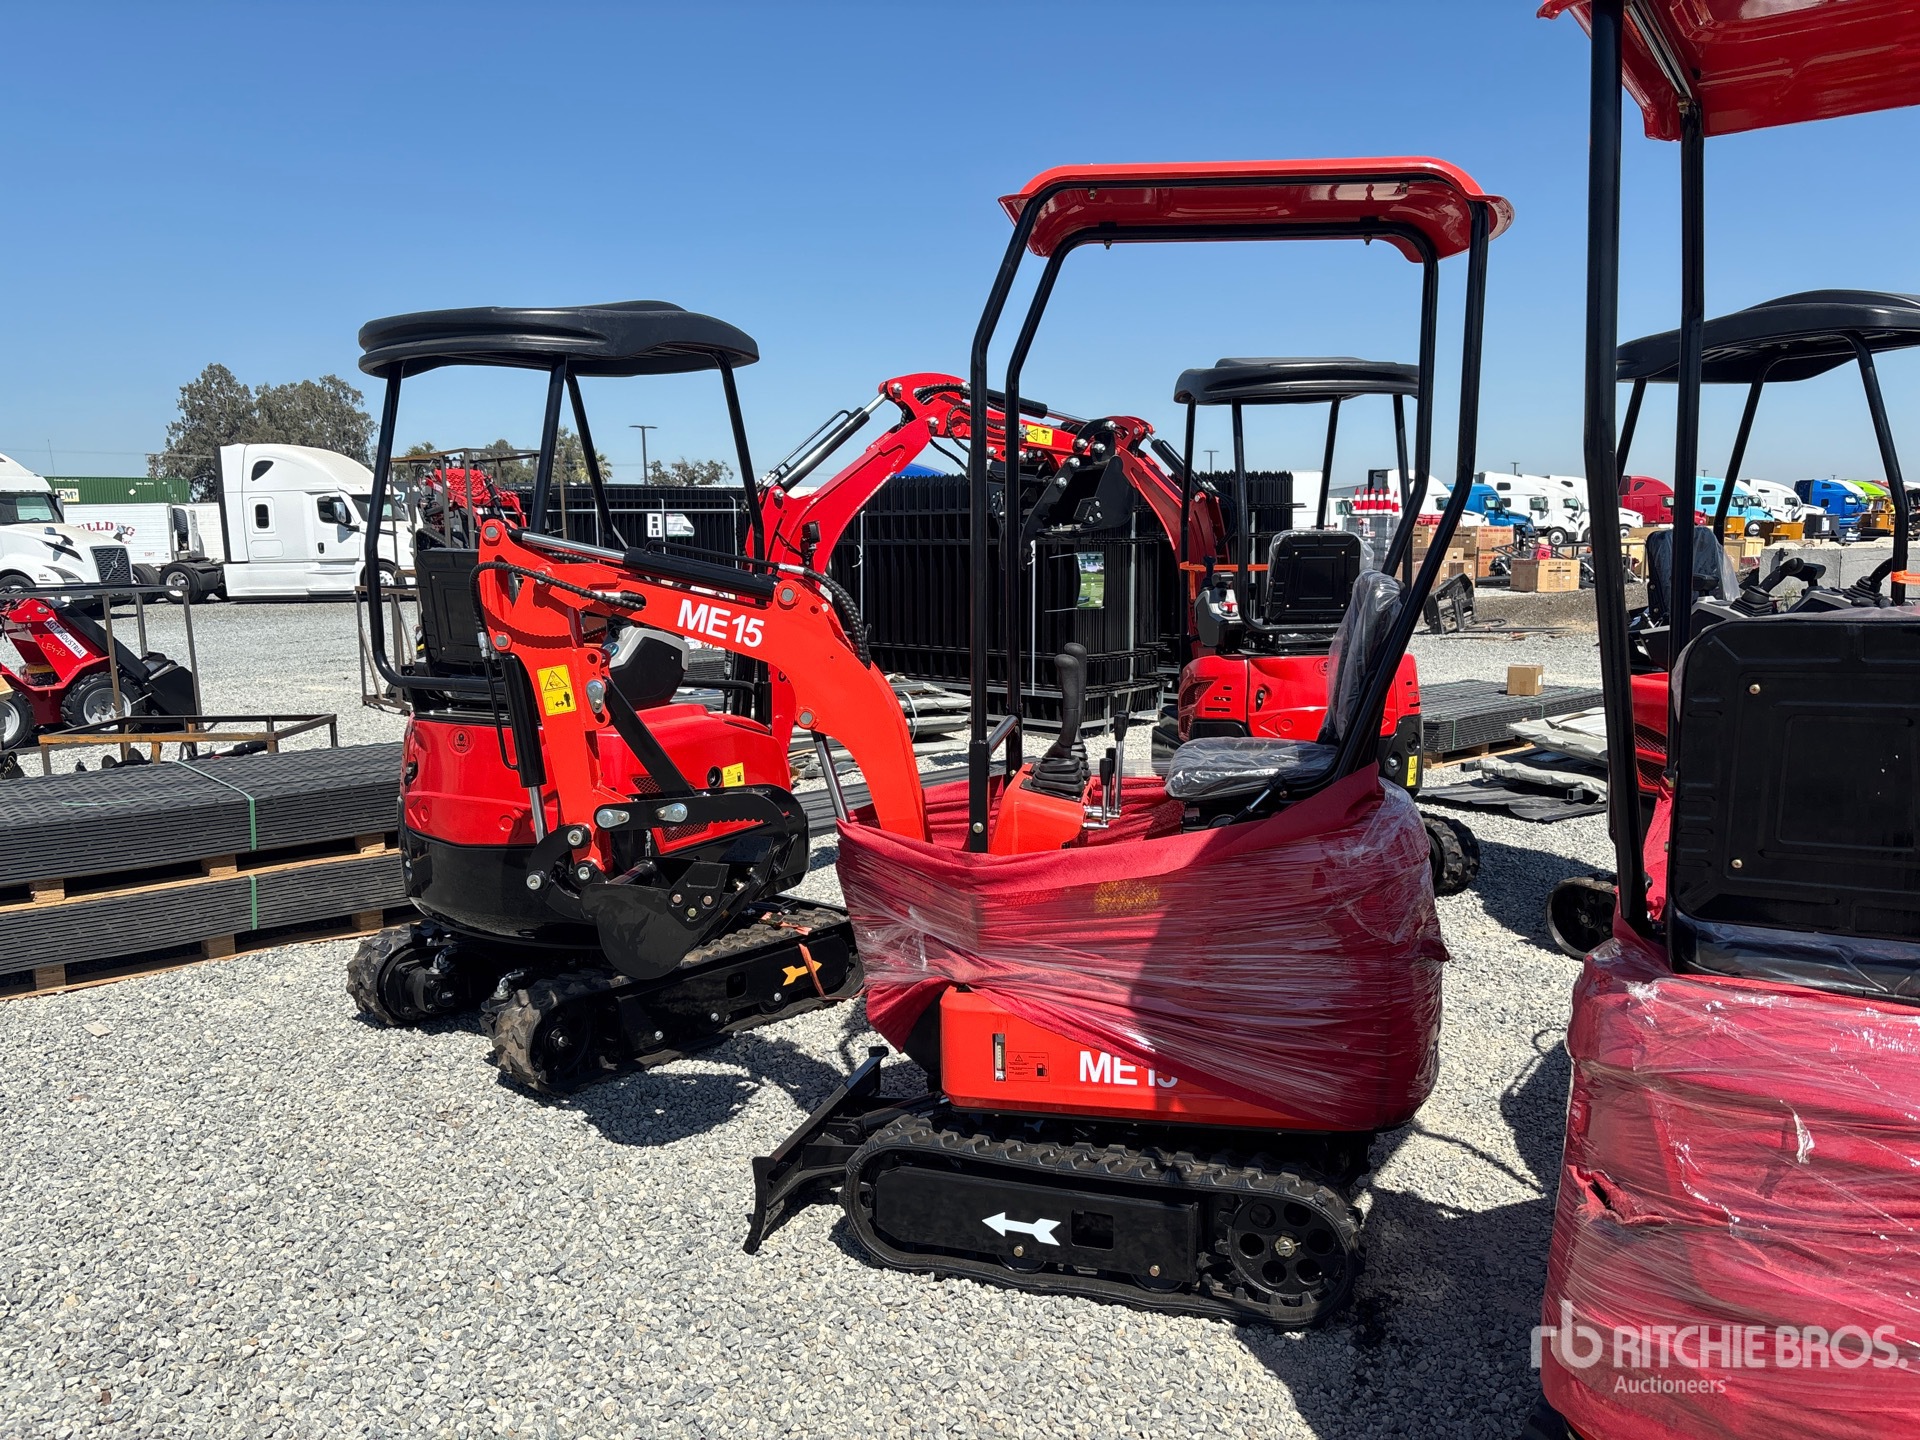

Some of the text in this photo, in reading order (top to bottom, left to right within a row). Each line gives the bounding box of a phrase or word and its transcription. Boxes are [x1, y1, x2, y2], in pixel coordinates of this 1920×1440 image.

[45, 618, 86, 657] AGT INDUSTRIAL
[677, 598, 765, 648] ME15
